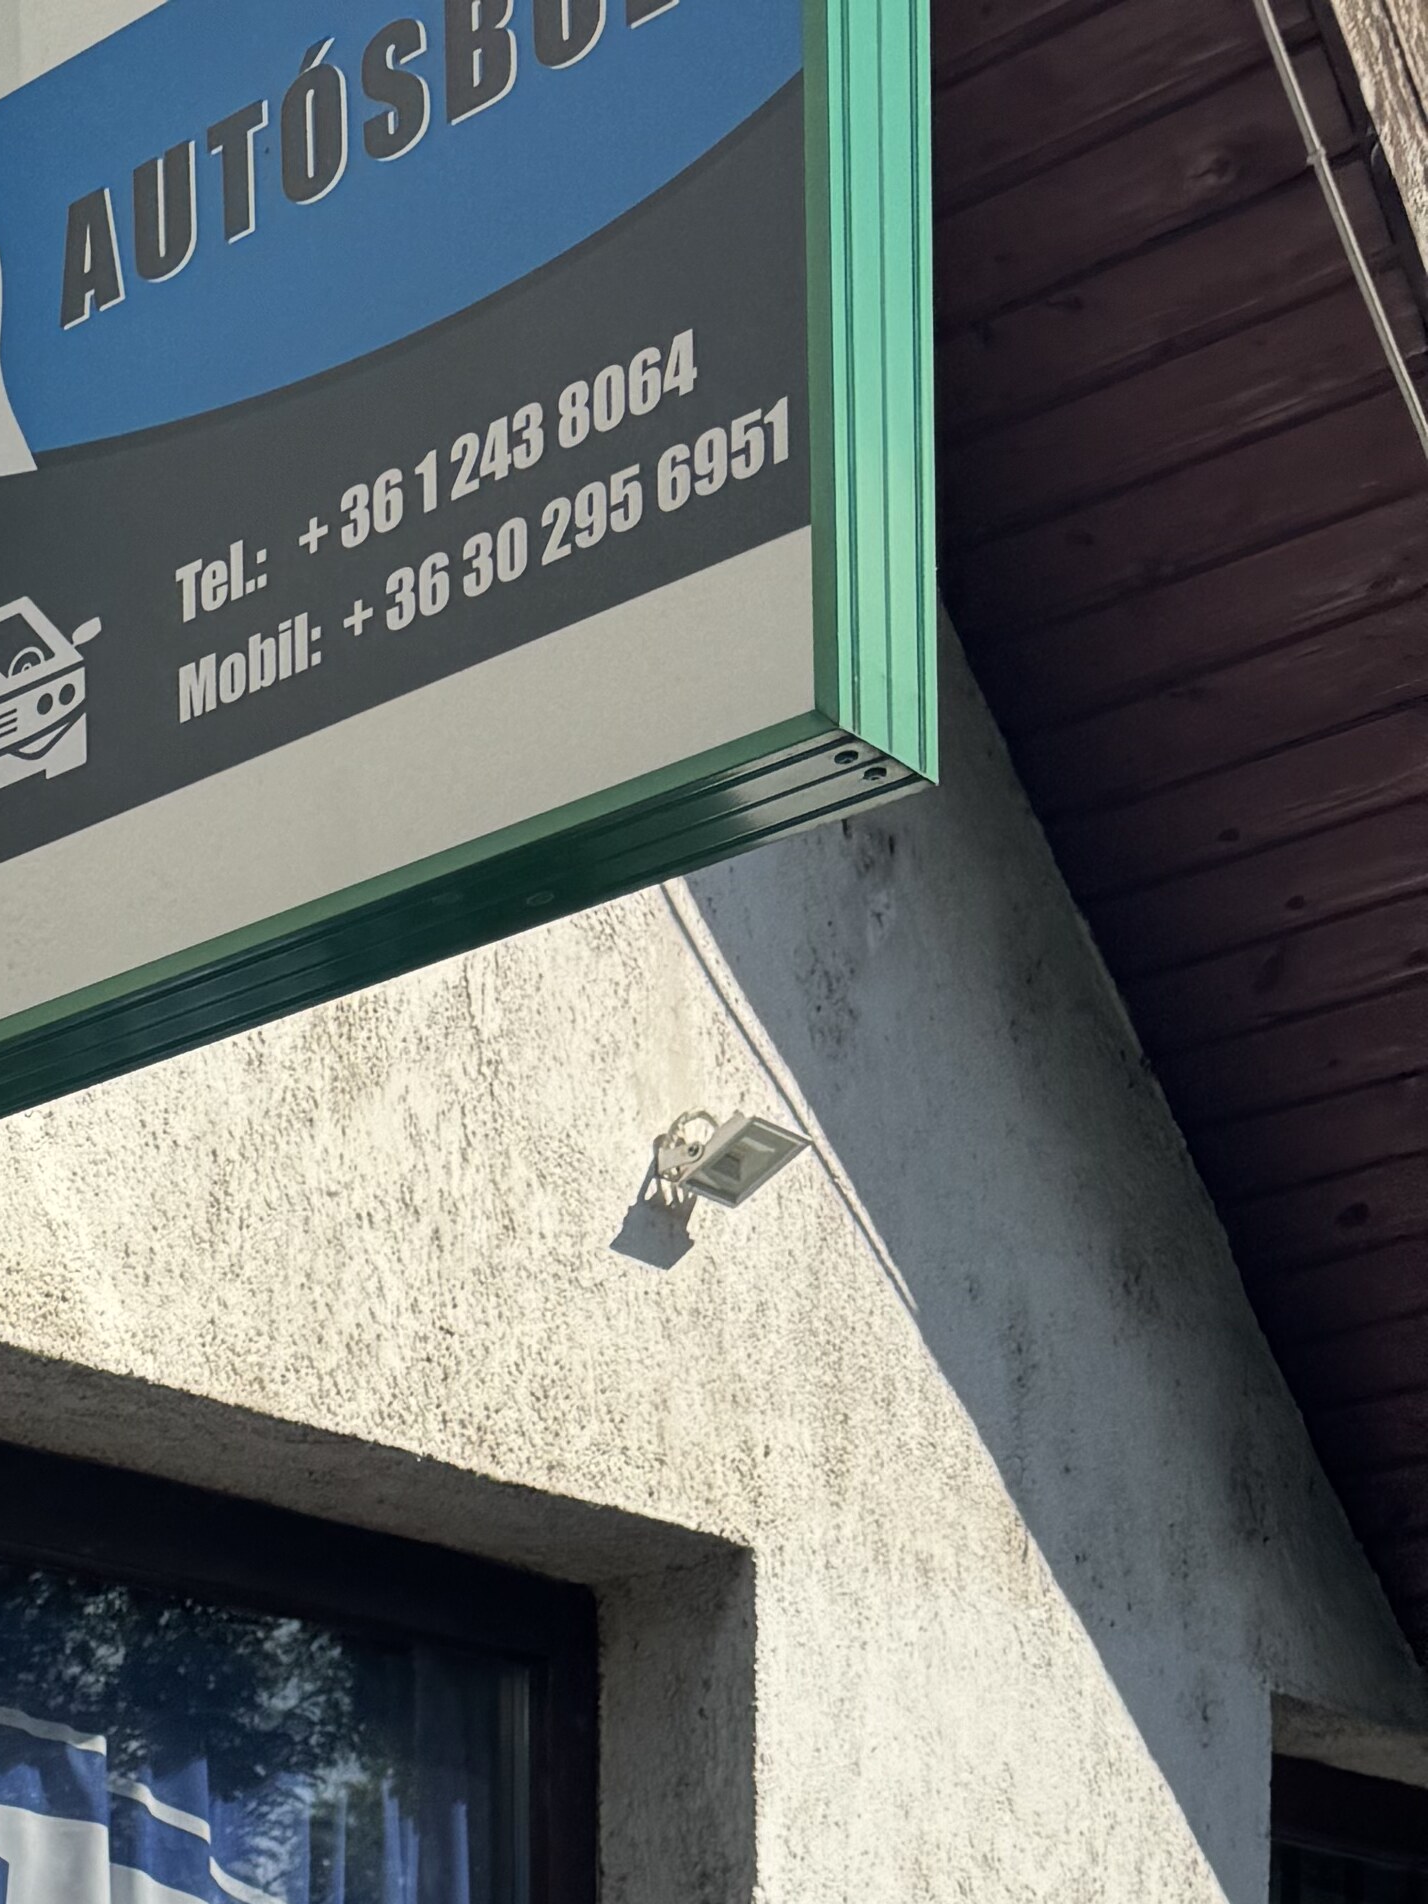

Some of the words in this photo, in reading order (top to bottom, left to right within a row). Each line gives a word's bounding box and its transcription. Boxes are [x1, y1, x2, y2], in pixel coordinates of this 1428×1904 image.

[60, 0, 680, 330] AUTÓSBO
[176, 539, 267, 623] Tel.:
[341, 468, 403, 549] 36
[415, 450, 438, 512] 1
[451, 402, 544, 501] 243
[558, 328, 697, 449] 8064
[179, 612, 321, 724] Mobil:
[386, 551, 450, 632] 36
[463, 517, 527, 598] 30
[542, 463, 643, 566] 295
[658, 396, 789, 513] 6951
